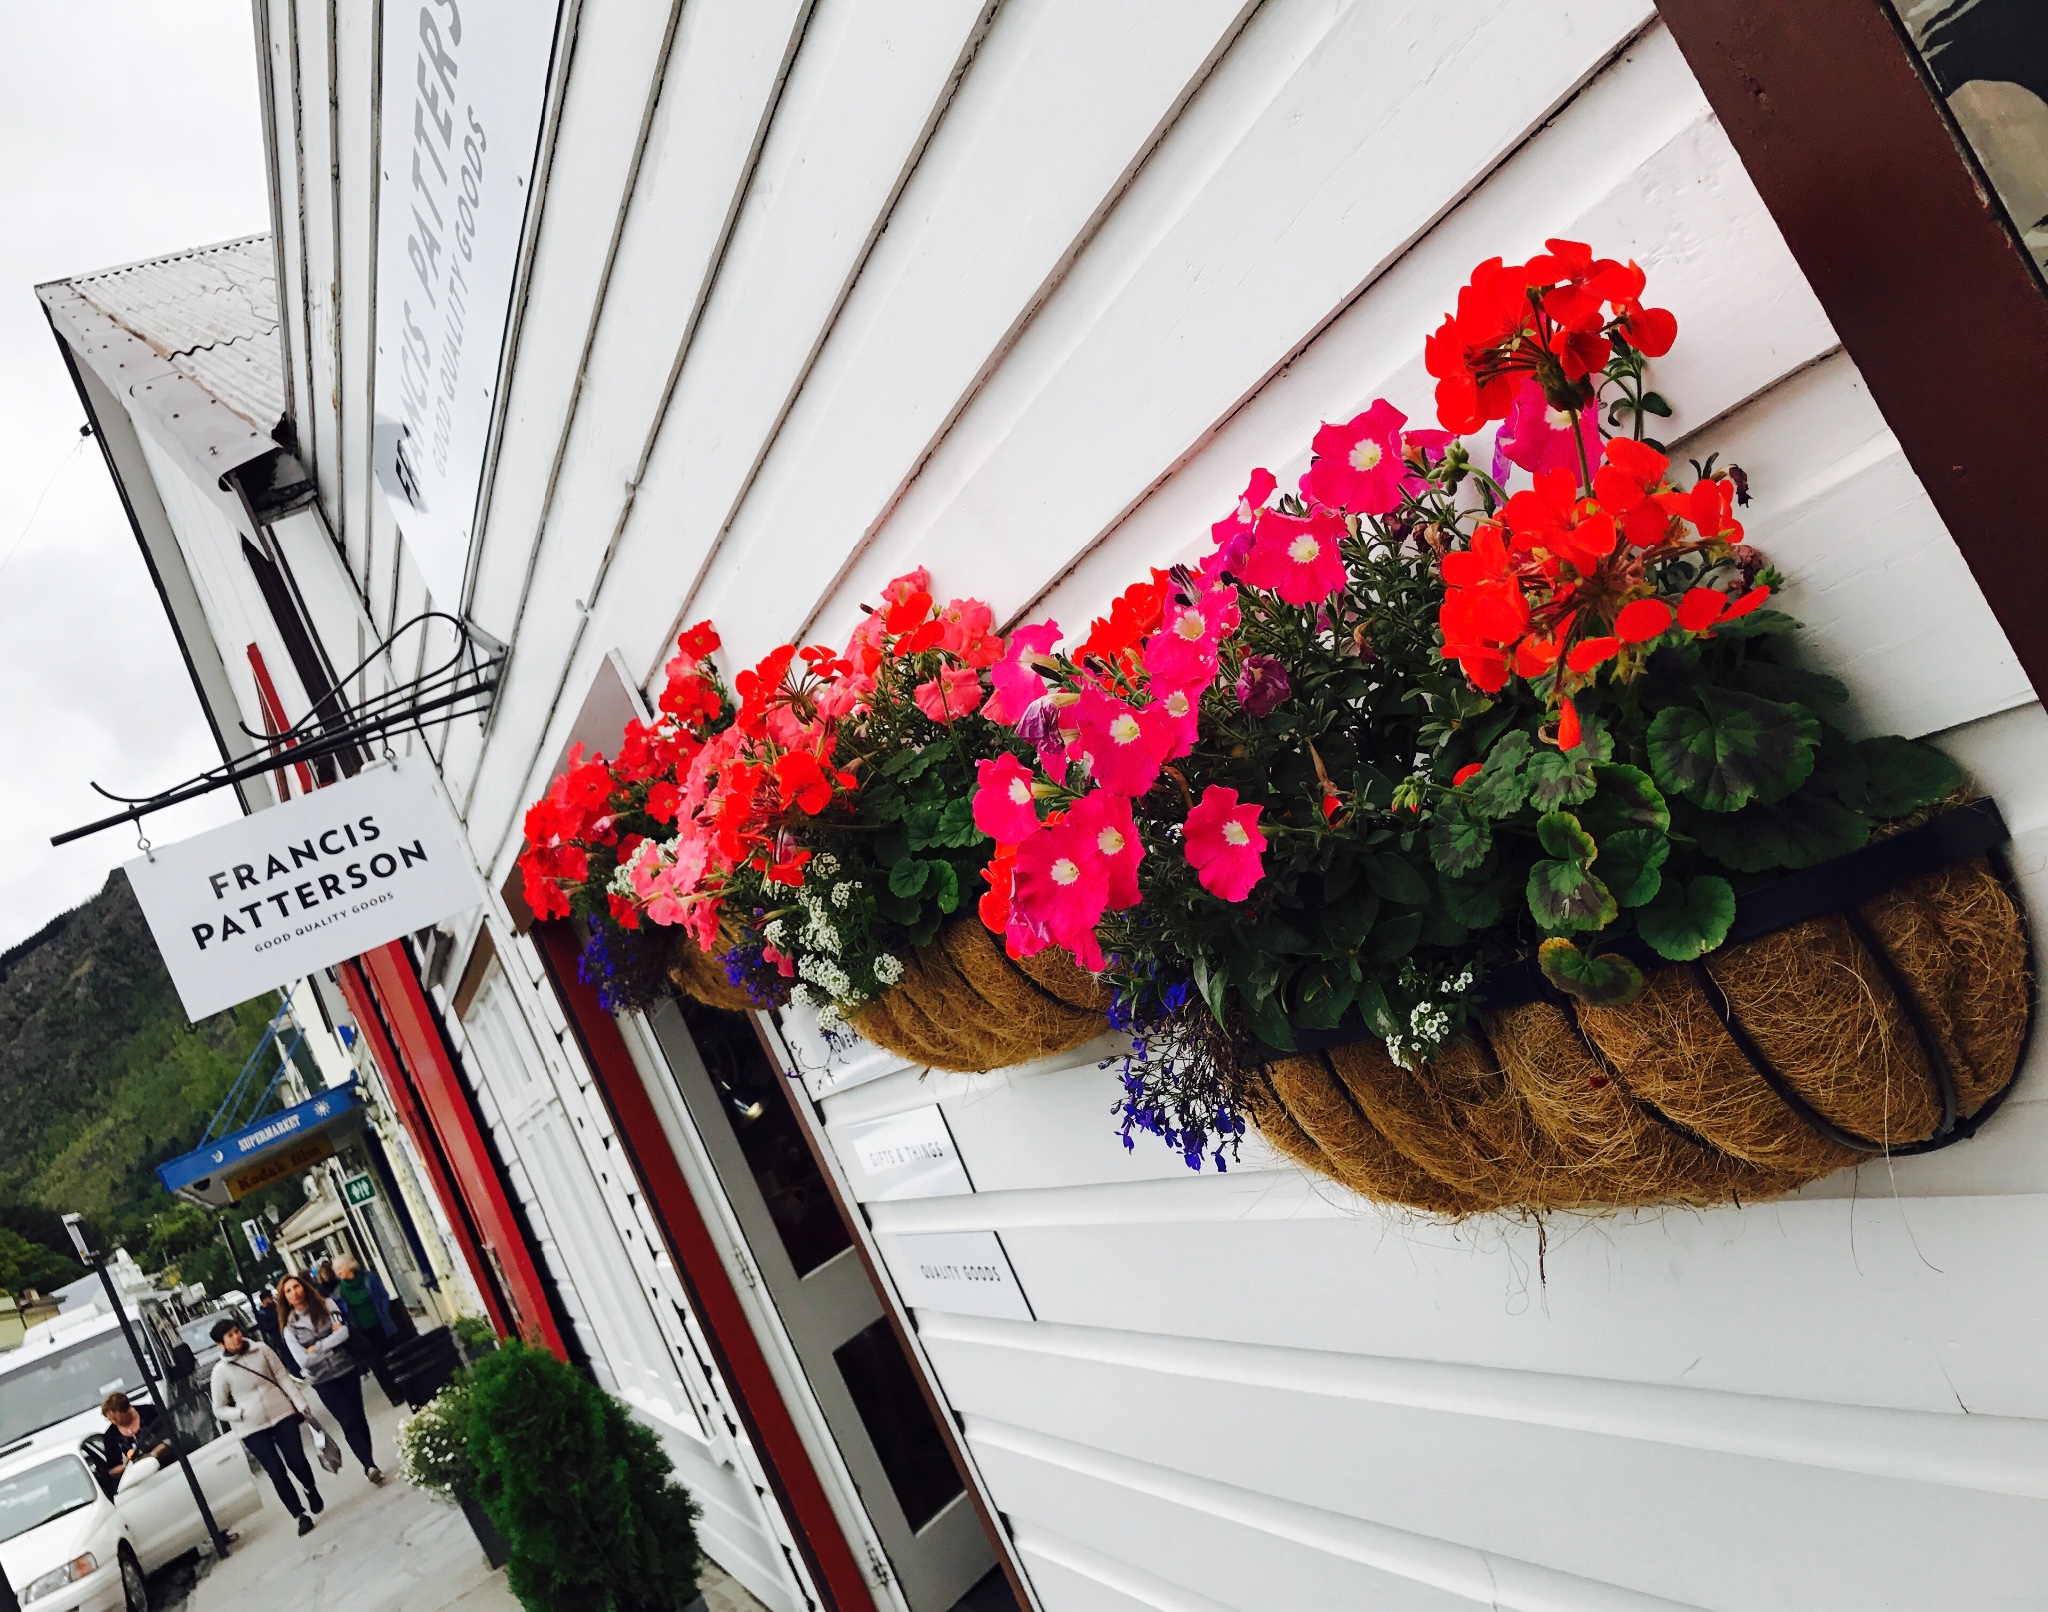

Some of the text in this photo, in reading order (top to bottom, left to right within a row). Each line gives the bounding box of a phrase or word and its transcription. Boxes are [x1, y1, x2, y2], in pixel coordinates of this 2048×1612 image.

[433, 104, 487, 479] GOOD QUALITY GOODS
[396, 299, 431, 512] FRANCIS
[208, 815, 381, 899] FRANCIS
[191, 839, 428, 951] PATTERSON
[255, 891, 395, 953] GOOD QUALITY GOODS
[237, 1113, 301, 1152] SUPERMARKET
[869, 1141, 943, 1167] GIFTS & THINGS
[920, 1264, 1001, 1282] QUALITY GOODS
